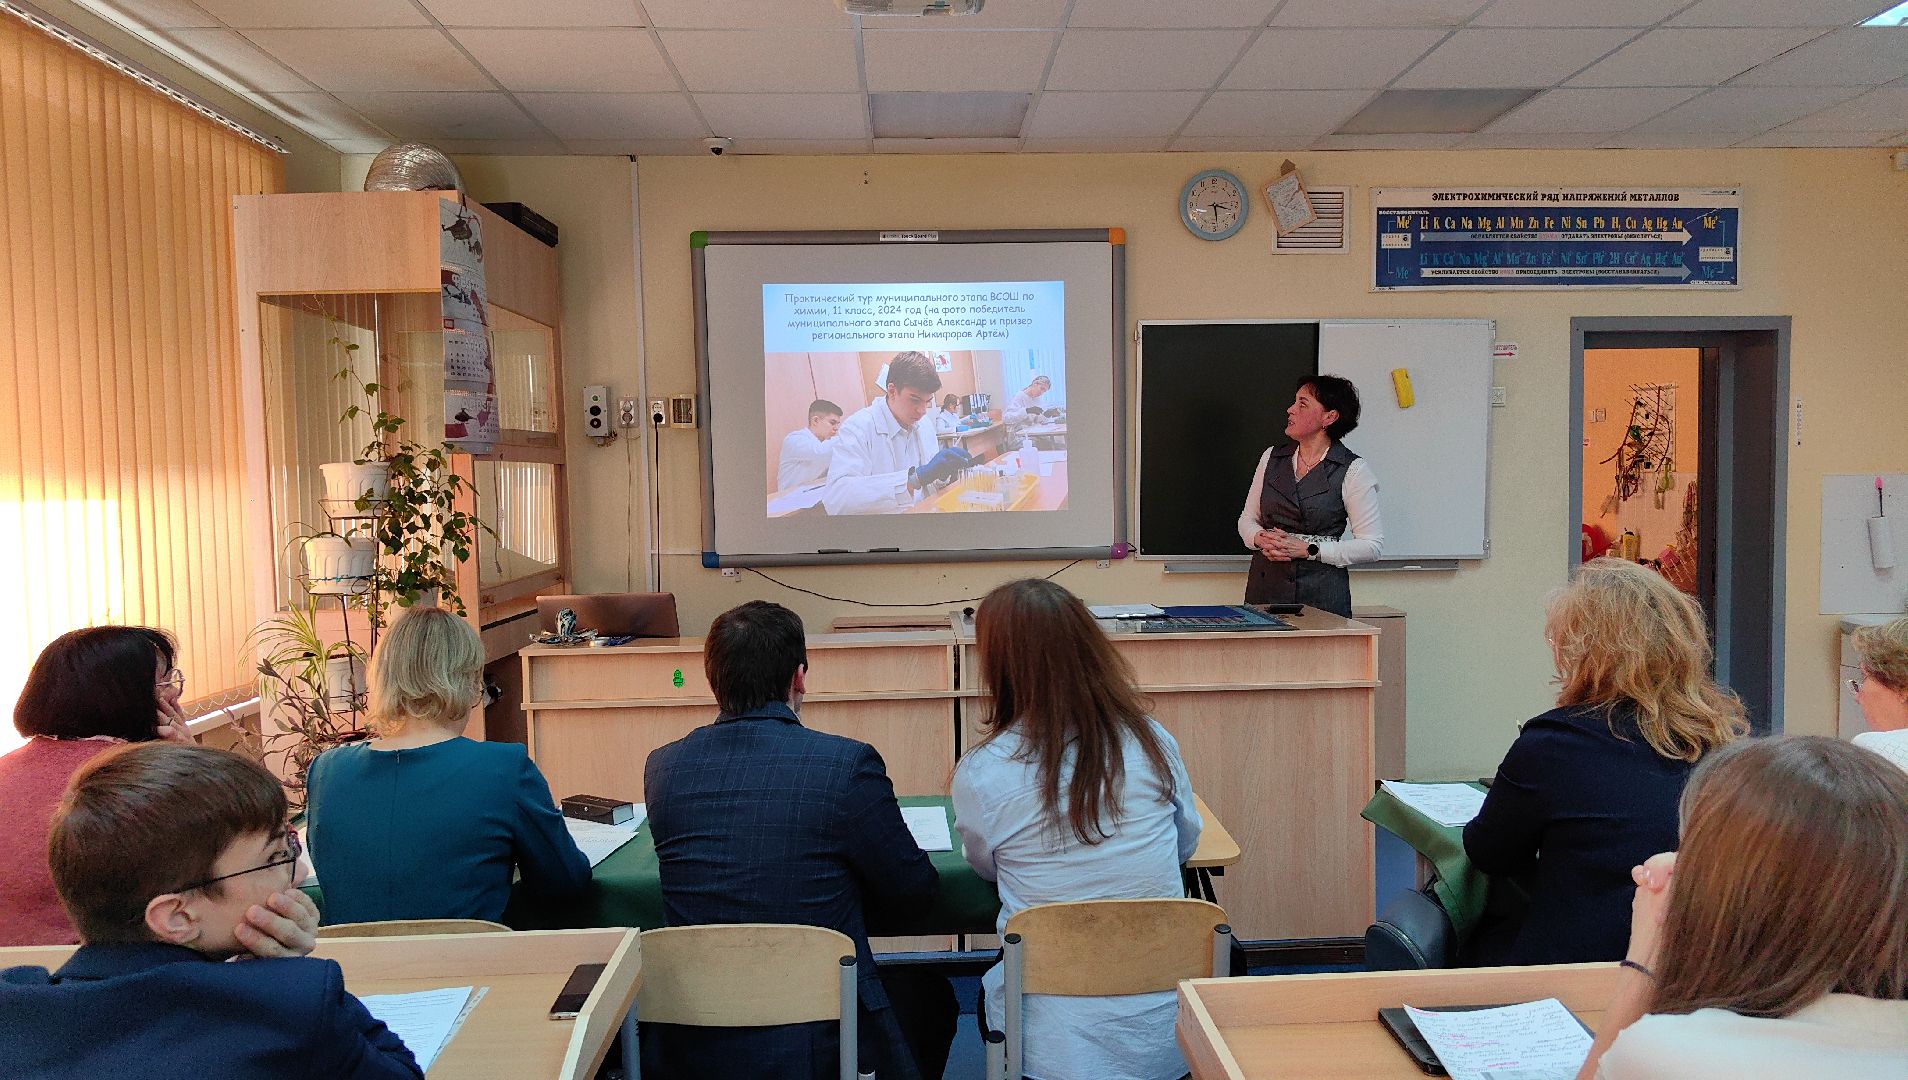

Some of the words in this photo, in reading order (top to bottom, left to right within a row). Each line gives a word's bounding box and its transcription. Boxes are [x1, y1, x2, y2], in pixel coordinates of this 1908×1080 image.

[1432, 191, 1539, 201] ЭЛЕКТРОХИМИЧЕСКИЙ
[1540, 192, 1559, 202] РЯД
[1562, 191, 1627, 202] НАПРЯЖЕНИЙ
[1630, 193, 1680, 202] МЕТАЛЛОВ
[1420, 216, 1428, 229] Li
[1433, 216, 1440, 229] K
[1444, 216, 1456, 229] Ca
[1461, 216, 1472, 229] Na
[1478, 216, 1491, 231] Mg
[1496, 216, 1504, 229] Al
[1510, 216, 1524, 229] Mn
[1528, 216, 1539, 229] Zn
[1544, 216, 1554, 229] Fe
[1561, 216, 1571, 229] Ni
[1576, 216, 1587, 229] Sn
[1594, 216, 1605, 229] Pb
[1625, 216, 1637, 229] Cu
[1642, 216, 1652, 231] Ag
[1656, 216, 1668, 231] Hg
[1672, 216, 1683, 229] Au
[784, 294, 855, 305] Практический
[858, 296, 873, 305] тур
[876, 294, 958, 304] муниципального
[990, 292, 1019, 301] ВСОШ
[833, 306, 842, 314] 11
[845, 307, 875, 316] класс,
[878, 306, 902, 314] 2024
[905, 307, 922, 315] год
[924, 305, 939, 315] (на
[942, 306, 966, 316] фото
[970, 304, 1026, 314] победитель
[788, 319, 871, 329] муниципального
[874, 319, 900, 327] этапа
[904, 318, 933, 327] Сычёв
[937, 318, 987, 328] Александр
[812, 331, 885, 341] регионального
[917, 330, 972, 340] Никифоров
[975, 329, 1009, 340] Артём)
